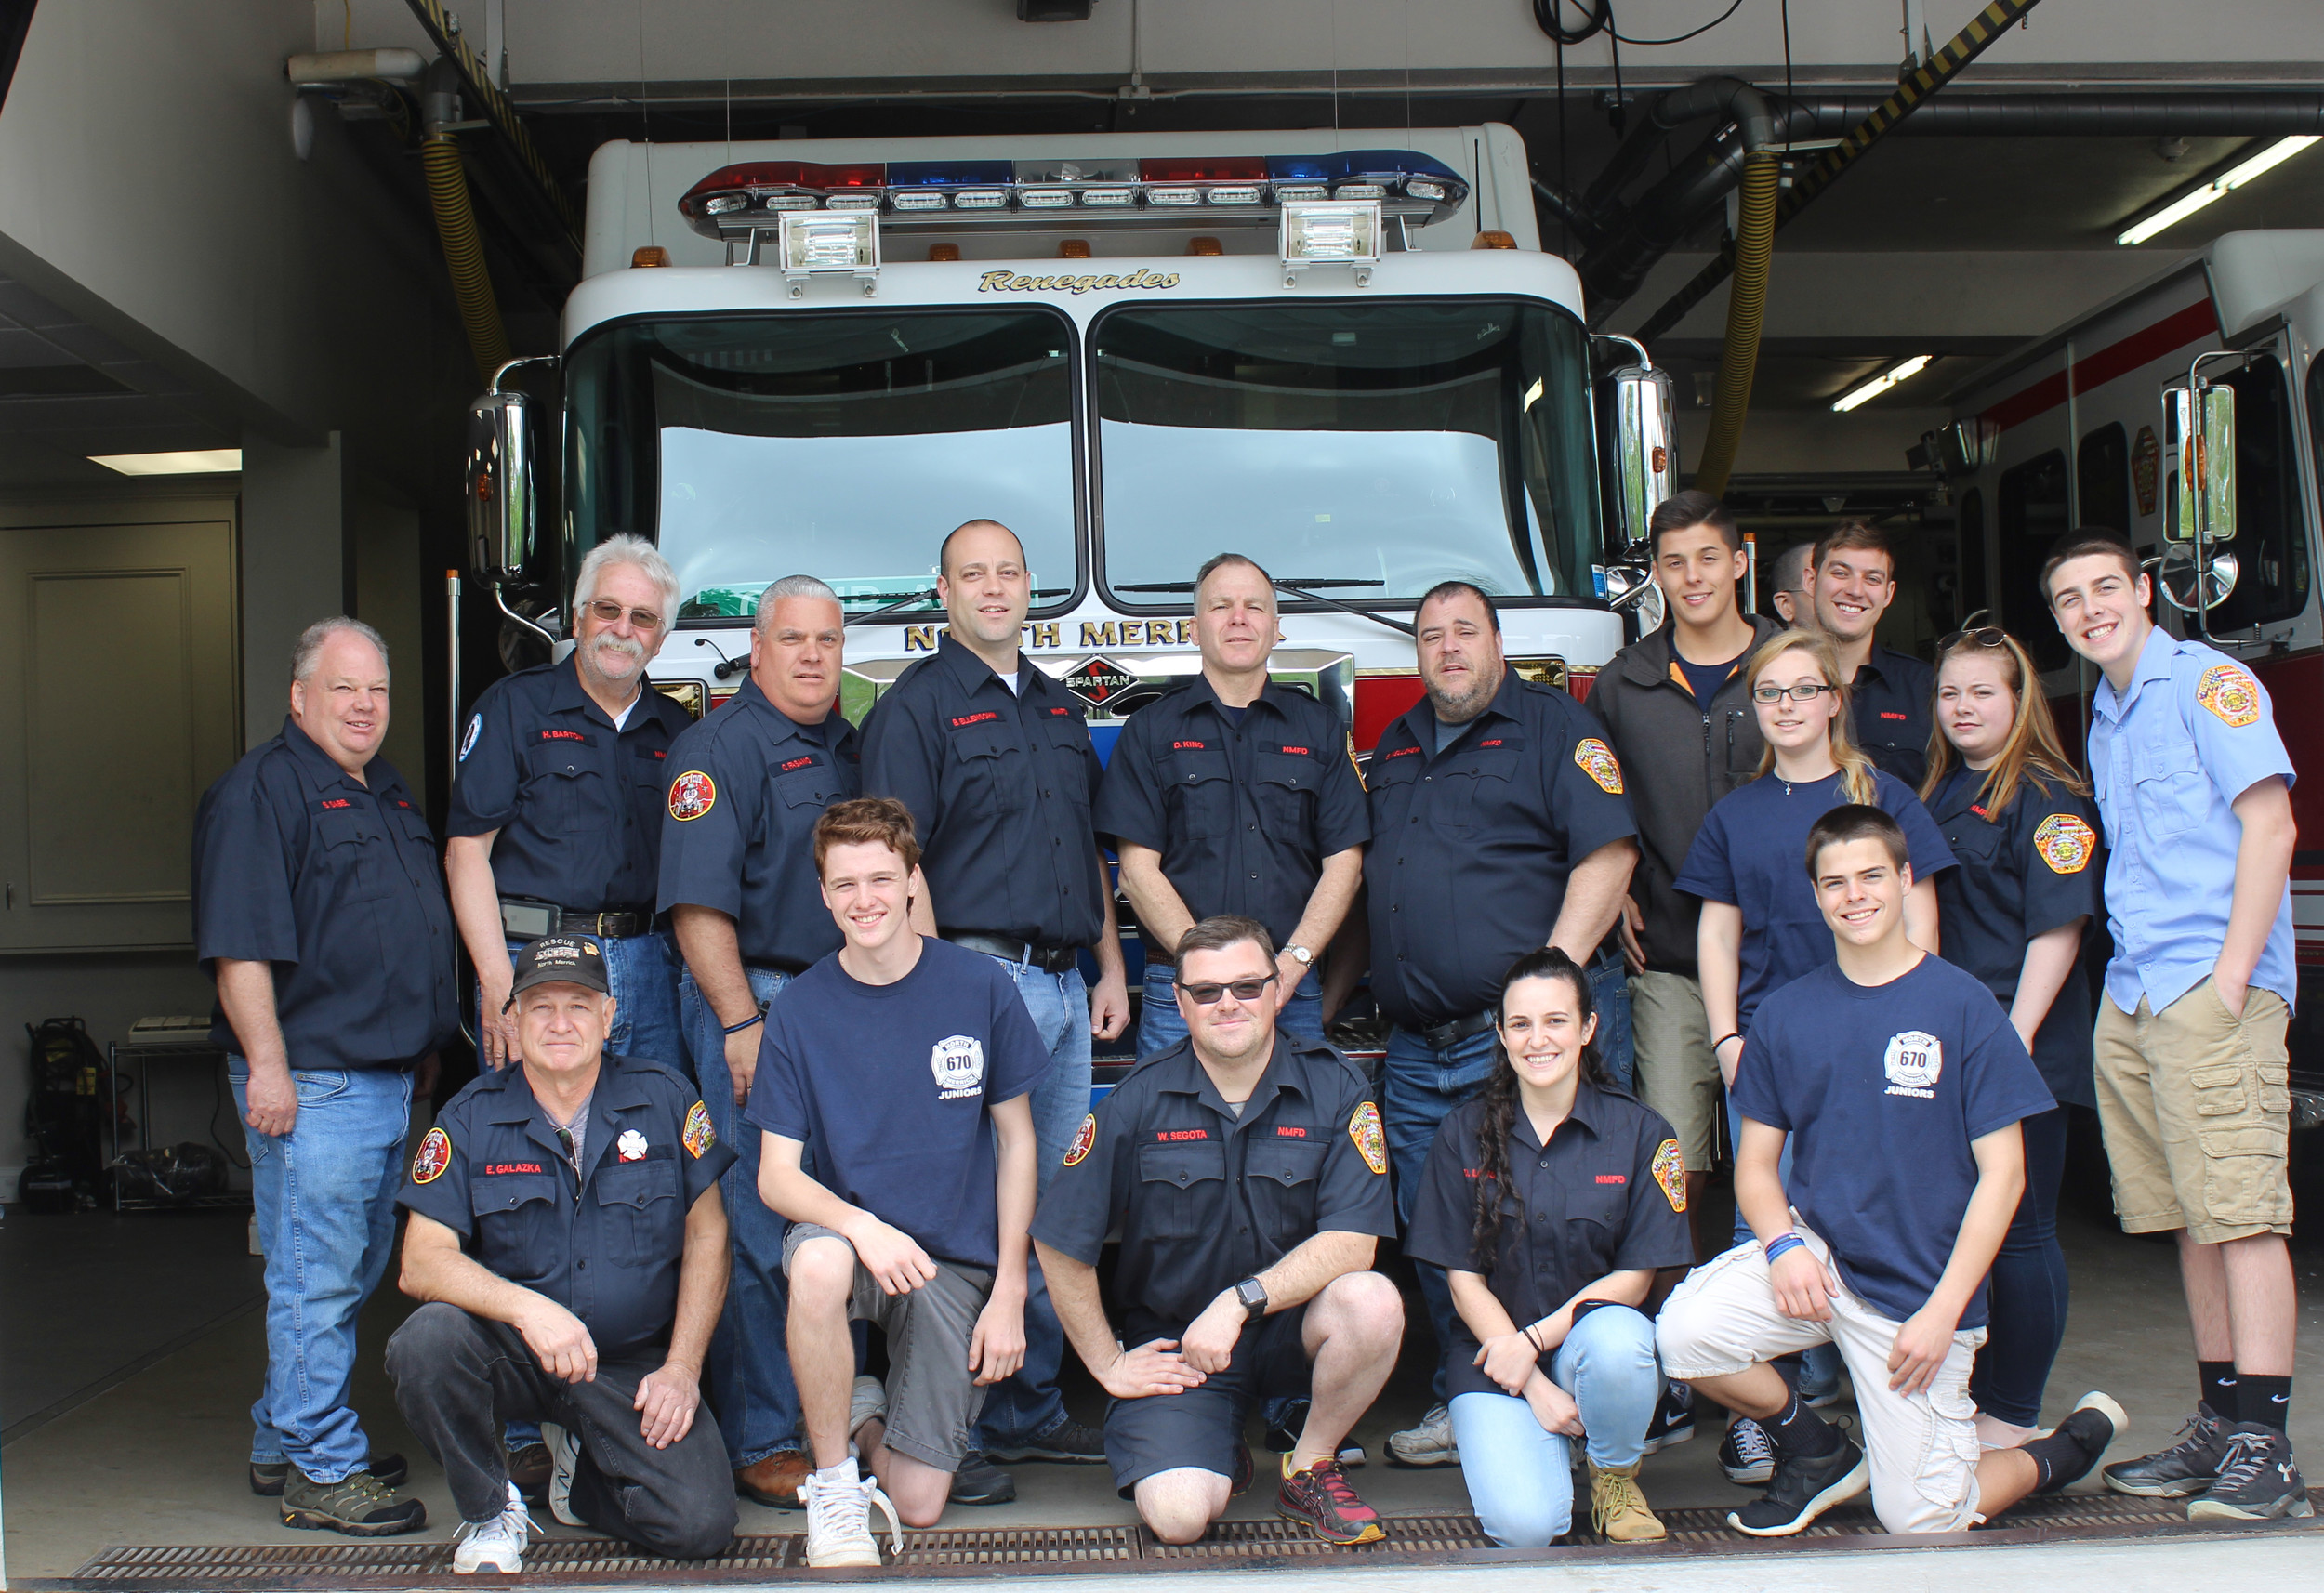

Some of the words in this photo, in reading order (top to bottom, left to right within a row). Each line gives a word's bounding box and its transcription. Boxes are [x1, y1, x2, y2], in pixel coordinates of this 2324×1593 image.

[978, 269, 1180, 295] Renegades
[904, 622, 1061, 652] NTH
[1079, 620, 1287, 649] MERR
[1065, 675, 1130, 688] SPARTAN
[1880, 711, 1908, 720] NMFD
[542, 731, 551, 739] H.
[552, 730, 585, 742] BARTON
[1173, 741, 1182, 749] D.
[1182, 740, 1205, 749] KING
[1480, 739, 1503, 747] NMFD
[1282, 745, 1309, 755] NMFD
[539, 938, 576, 948] RESCUE
[537, 960, 553, 968] North
[554, 959, 576, 968] Merrick
[944, 1039, 970, 1049] NORTH
[946, 1054, 971, 1071] 670
[1899, 1050, 1927, 1068] 670
[938, 1086, 983, 1099] JUNIORS
[1883, 1086, 1935, 1099] JUNIORS
[1157, 1131, 1169, 1141] W.
[1170, 1129, 1208, 1140] SEGOTA
[1277, 1126, 1306, 1138] NMFD
[485, 1165, 495, 1175] E.
[495, 1163, 542, 1175] GALAZKA
[1595, 1175, 1627, 1184] NMFD
